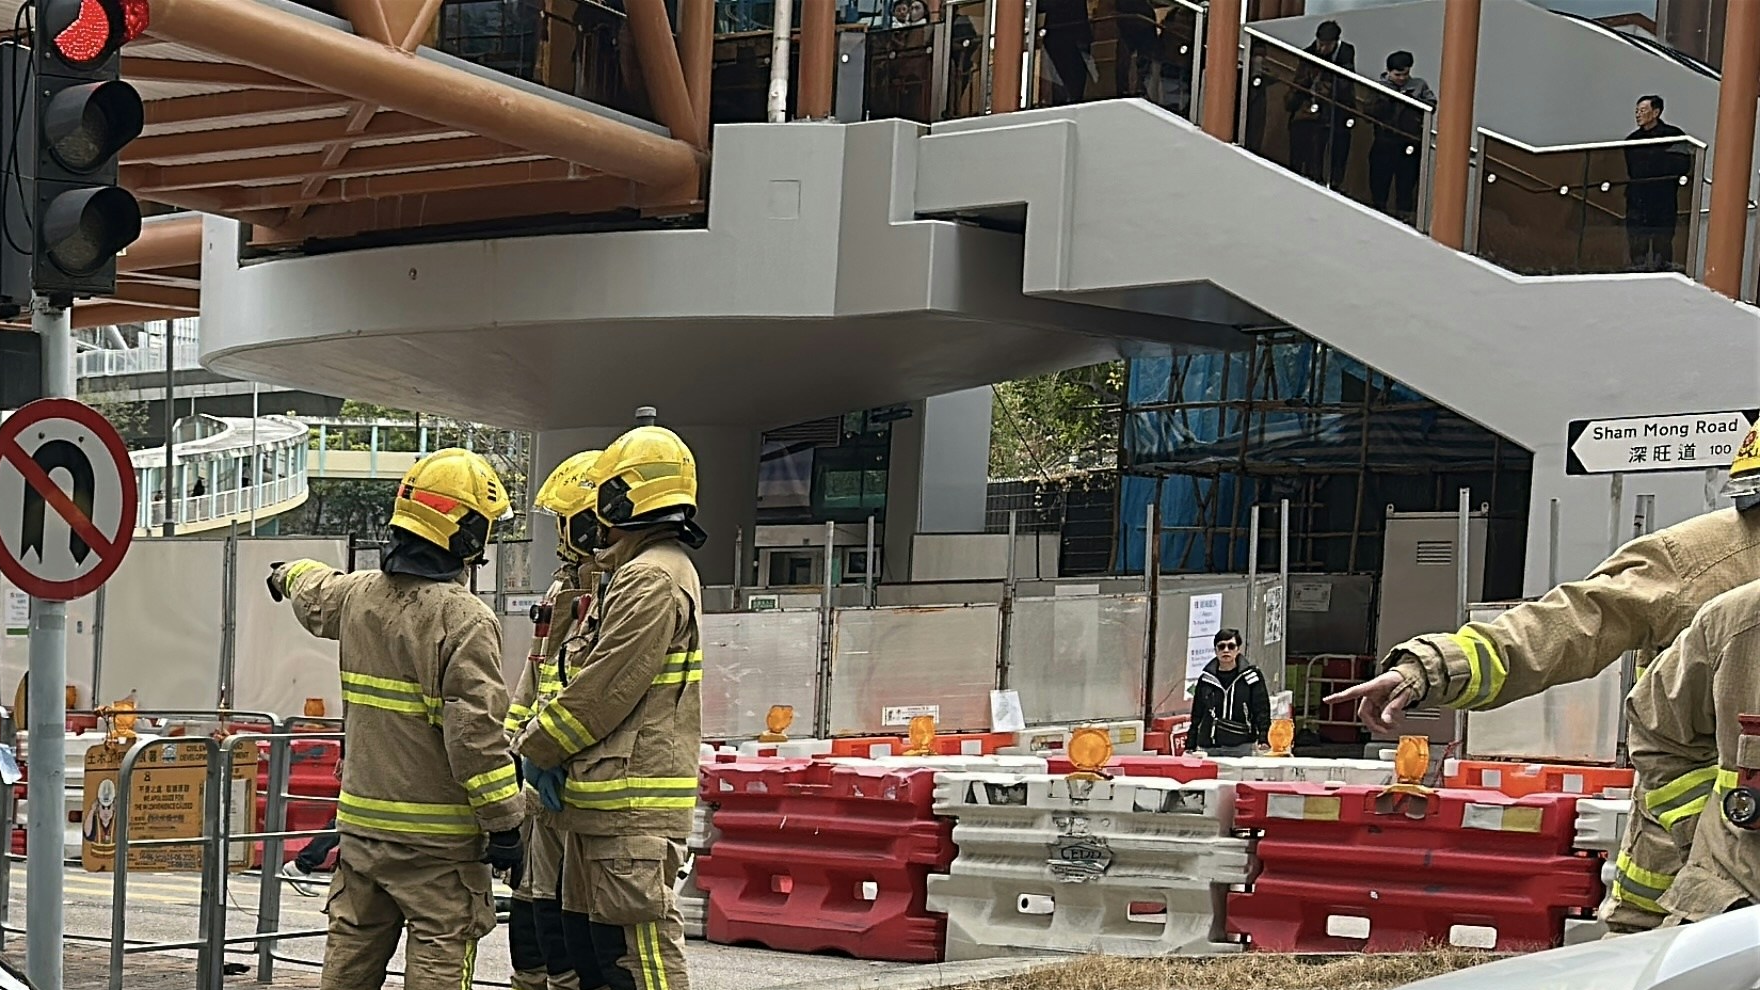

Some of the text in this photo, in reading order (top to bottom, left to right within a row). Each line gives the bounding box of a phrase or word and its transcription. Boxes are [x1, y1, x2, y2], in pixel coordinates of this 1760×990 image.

[1593, 418, 1739, 440] Sham Mong Road
[1628, 443, 1732, 463] 深旺道 100
